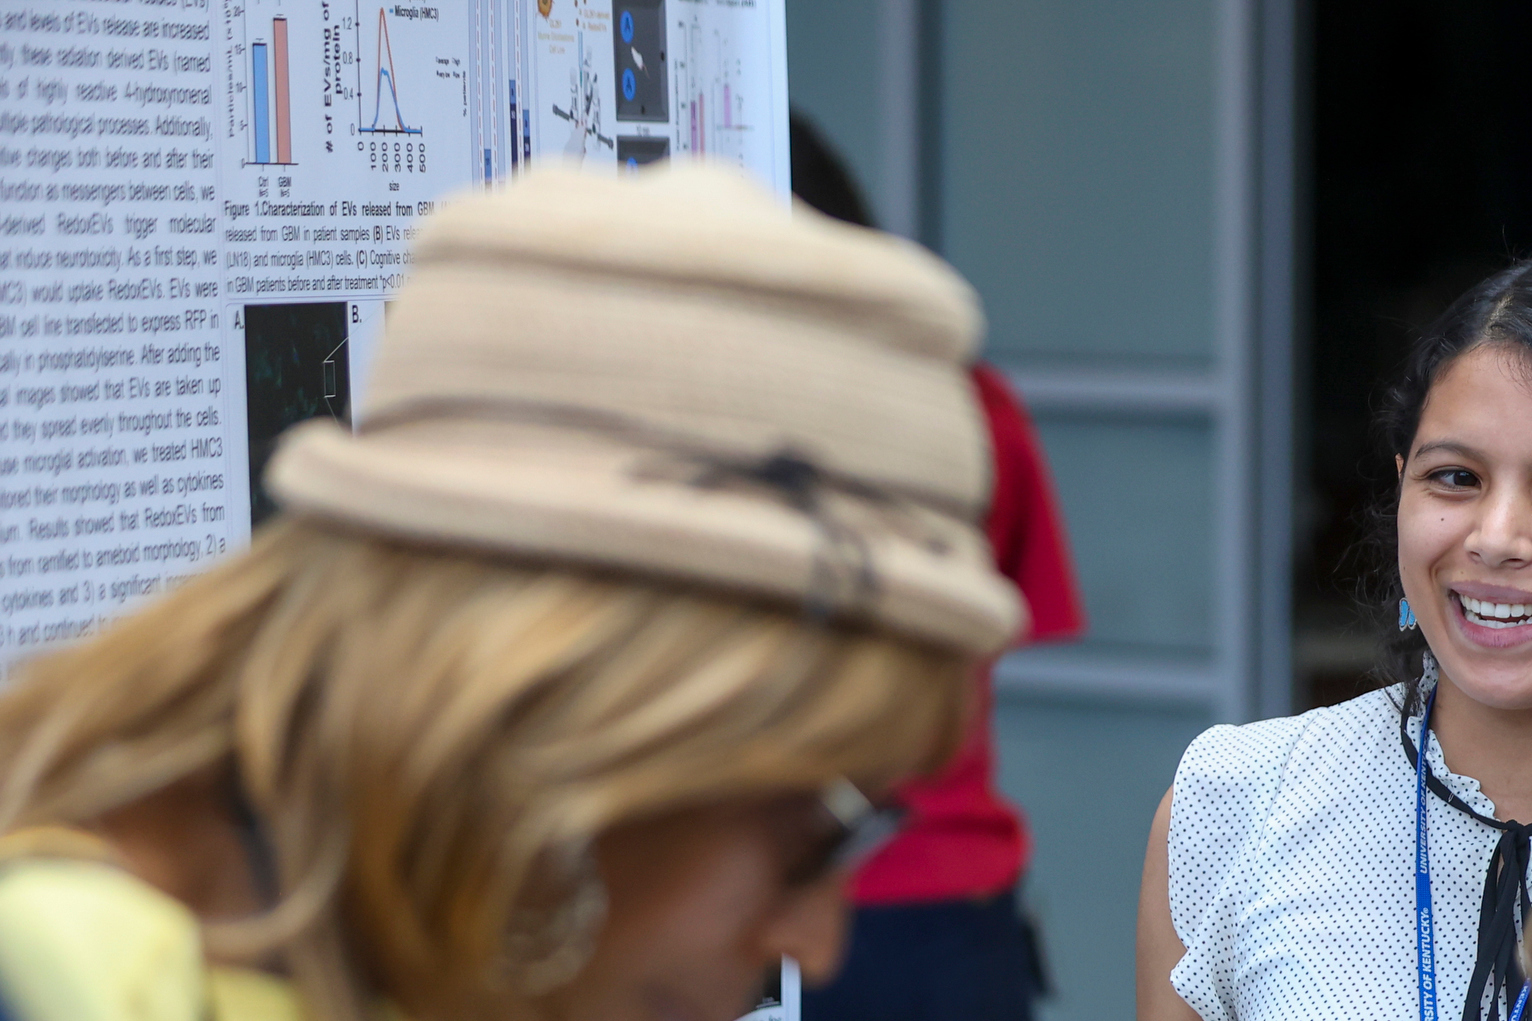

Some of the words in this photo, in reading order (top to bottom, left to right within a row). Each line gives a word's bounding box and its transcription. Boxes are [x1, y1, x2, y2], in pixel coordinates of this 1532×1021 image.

[343, 17, 352, 30] 1.2
[394, 5, 419, 19] Microglia
[420, 8, 439, 22] (HMC3)
[143, 21, 160, 38] are
[162, 18, 210, 41] increased
[107, 47, 145, 70] derived
[149, 50, 169, 71] EVs
[174, 50, 211, 75] (named
[332, 24, 343, 95] protein
[343, 51, 353, 65] 0.8
[343, 87, 353, 100] 0.4
[155, 114, 213, 142] Additionally,
[324, 114, 333, 134] of
[350, 123, 355, 136] 0
[105, 146, 139, 168] before
[143, 147, 162, 169] and
[165, 147, 188, 169] after
[192, 148, 214, 169] their
[406, 142, 414, 173] 400
[129, 178, 171, 201] between
[173, 180, 198, 203] cells,
[200, 184, 216, 201] we
[389, 181, 400, 192] size
[224, 200, 249, 220] Figure
[254, 200, 325, 217] 1.Characterization
[330, 200, 338, 216] of
[342, 201, 358, 216] EVs
[362, 201, 390, 217] released
[396, 200, 413, 217] from
[126, 213, 158, 240] trigger
[169, 214, 217, 235] molecular
[225, 227, 257, 242] released
[261, 226, 278, 241] from
[281, 225, 300, 241] GBM
[303, 225, 311, 241] in
[314, 226, 337, 244] patient
[341, 226, 370, 245] samples
[373, 225, 383, 244] (B)
[386, 225, 400, 241] EVs
[144, 252, 151, 267] a
[155, 245, 174, 267] first
[176, 247, 200, 271] step,
[203, 250, 218, 266] we
[254, 251, 268, 267] and
[271, 251, 303, 270] microglia
[306, 250, 333, 270] (HMC3)
[336, 249, 354, 266] cells.
[357, 249, 368, 269] (C)
[371, 249, 400, 269] Cognitive
[108, 278, 166, 300] RedoxEVs.
[170, 277, 191, 299] EVs
[195, 281, 219, 298] were
[227, 277, 233, 292] in
[236, 277, 254, 292] GBM
[257, 275, 286, 294] patients
[288, 275, 310, 291] before
[313, 275, 325, 290] and
[327, 274, 342, 290] after
[345, 274, 378, 290] treatment
[141, 313, 181, 334] express
[185, 309, 207, 330] RFP
[210, 311, 220, 329] in
[352, 305, 362, 324] B.
[141, 343, 165, 365] After
[168, 341, 201, 367] adding
[204, 341, 220, 361] the
[129, 376, 151, 399] EVs
[155, 381, 172, 397] are
[175, 378, 204, 395] taken
[208, 378, 221, 397] up
[119, 408, 173, 436] throughout
[176, 408, 193, 428] the
[196, 406, 222, 427] cells.
[134, 447, 148, 463] we
[152, 442, 187, 462] treated
[191, 436, 224, 458] HMC3
[124, 482, 137, 497] as
[140, 475, 160, 495] well
[162, 479, 175, 495] as
[177, 471, 225, 497] cytokines
[119, 510, 140, 532] that
[145, 506, 198, 529] RedoxEVs
[202, 502, 225, 523] from
[1420, 790, 1427, 805] OF
[1420, 806, 1428, 875] UNIVERSITY
[1422, 974, 1433, 991] OF
